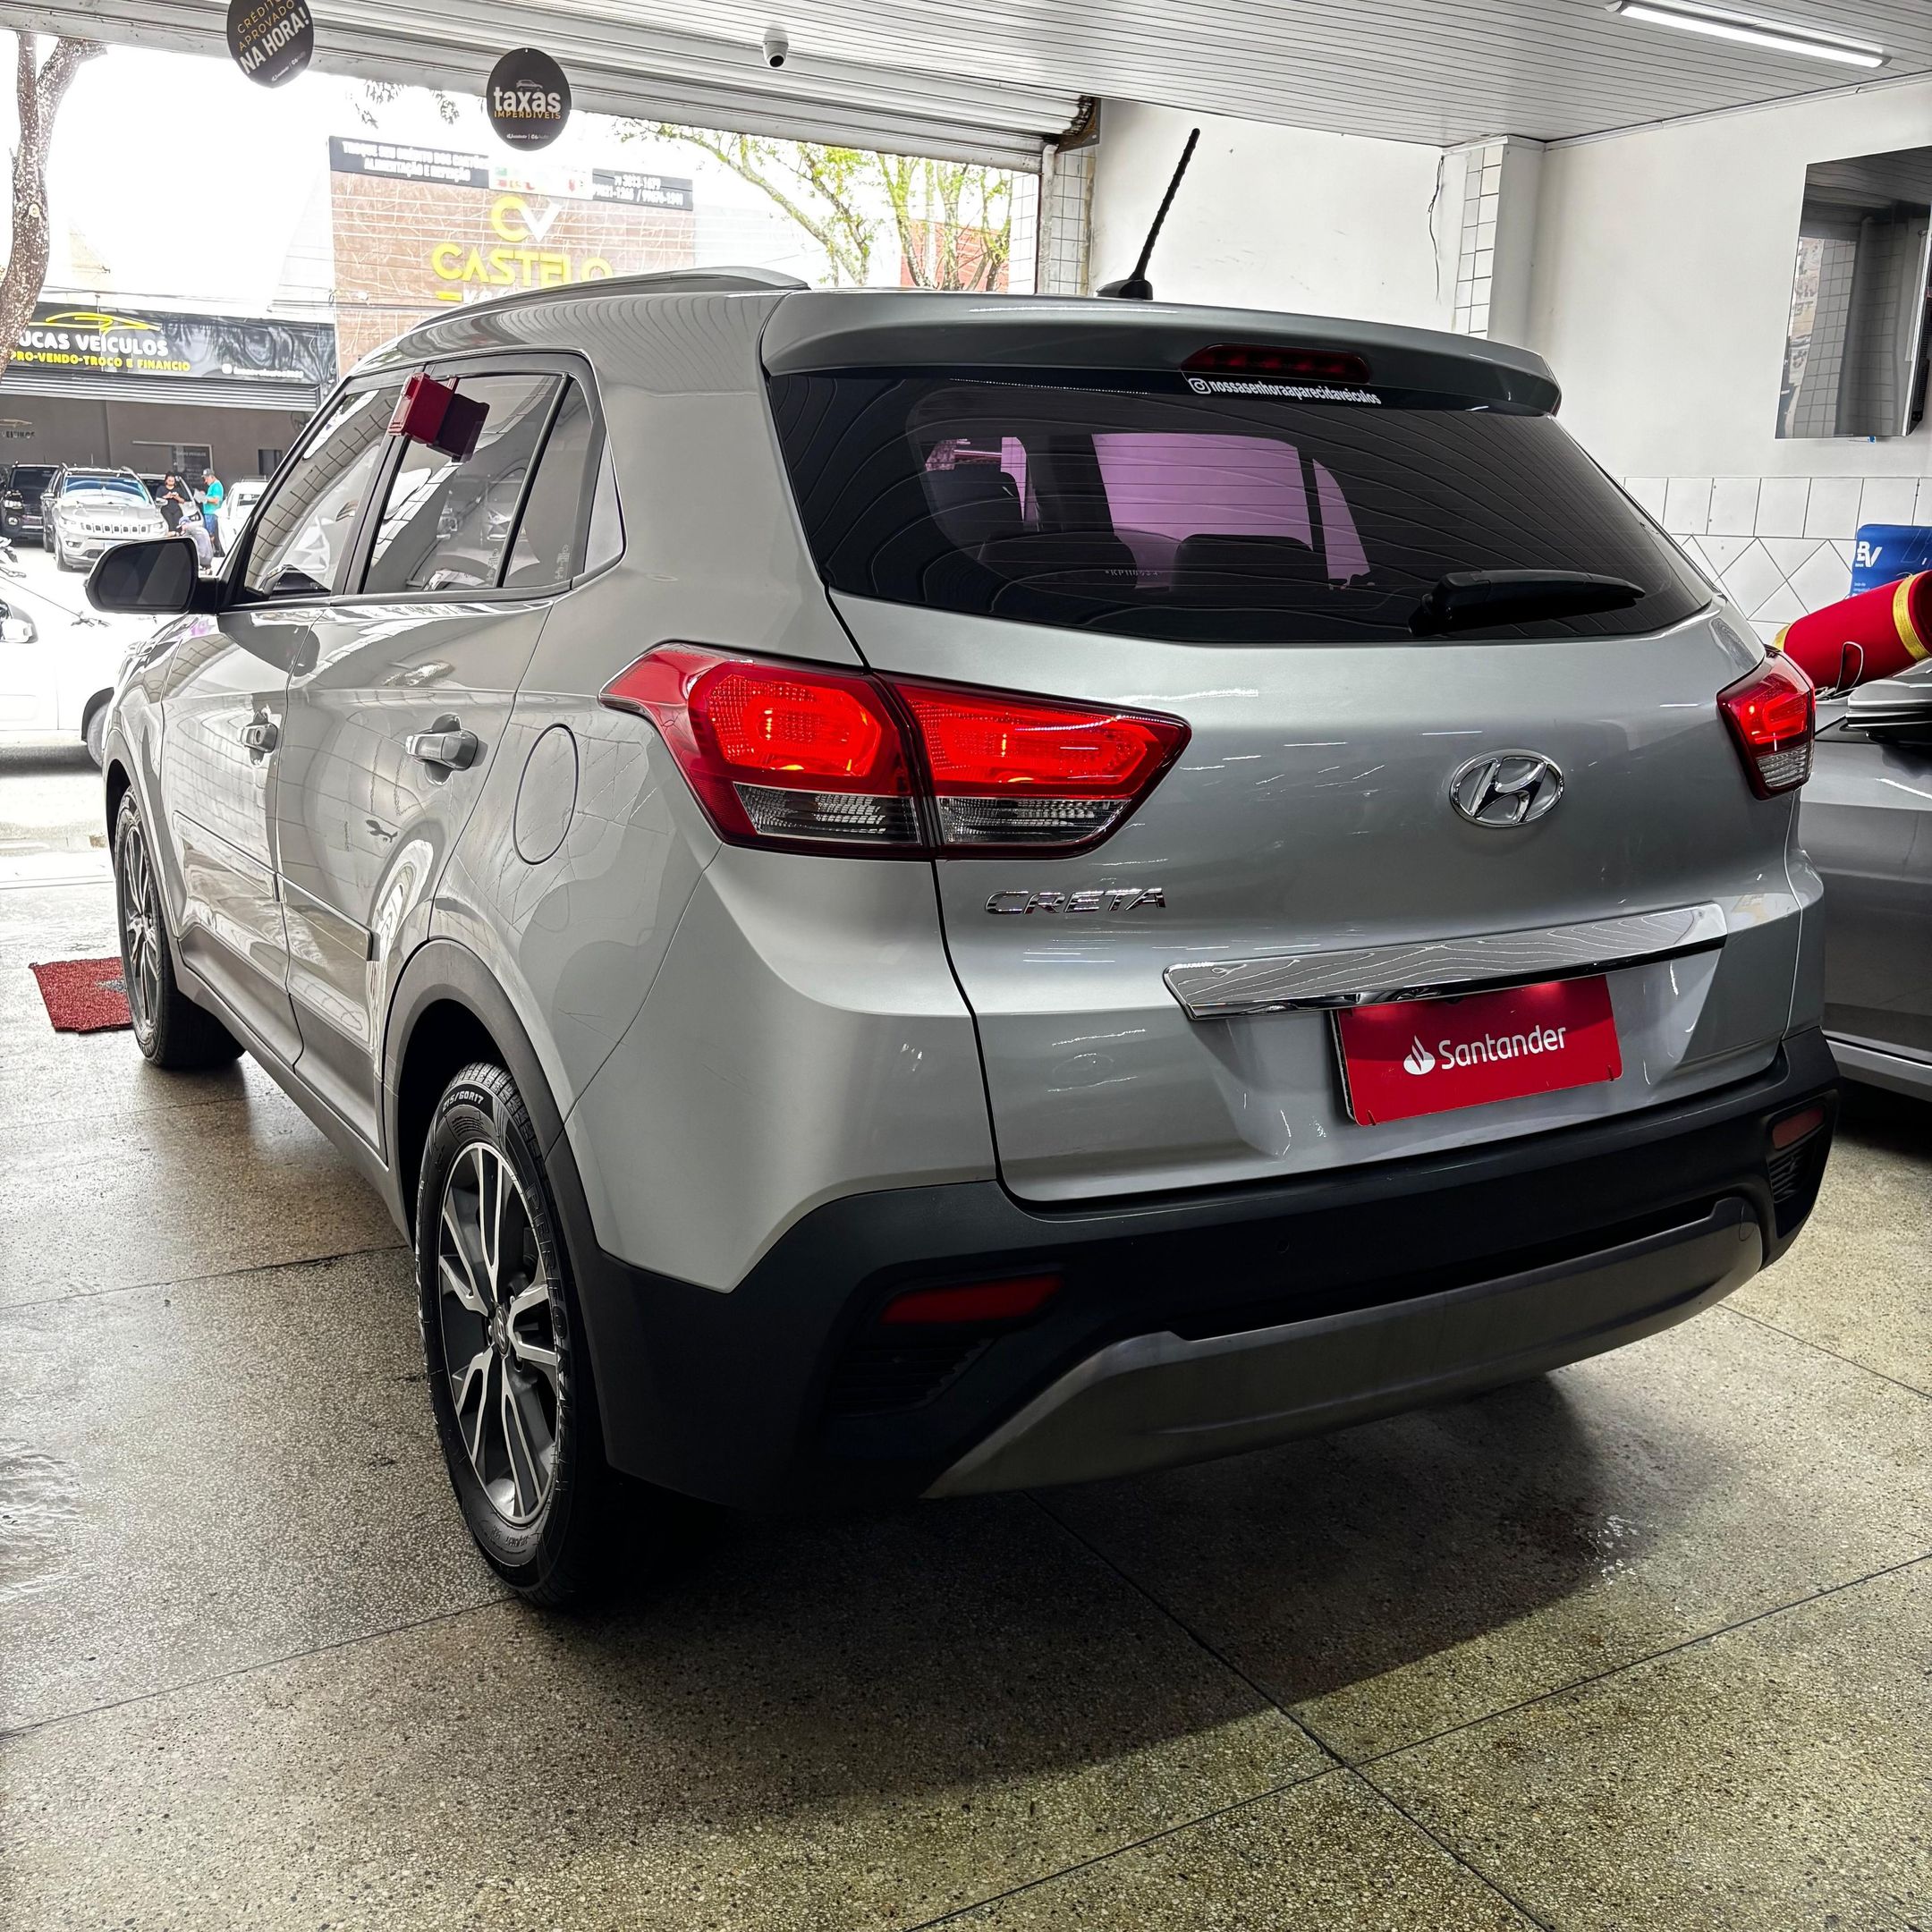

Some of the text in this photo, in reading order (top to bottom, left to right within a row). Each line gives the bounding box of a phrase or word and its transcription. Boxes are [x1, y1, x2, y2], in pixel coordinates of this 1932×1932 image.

[237, 0, 280, 34] CRÉDIT
[239, 0, 294, 51] APROVADO
[240, 46, 267, 74] NA
[262, 6, 309, 56] HORA!
[494, 87, 561, 113] taxas
[491, 196, 563, 243] CV
[19, 331, 71, 350] UCAS
[126, 358, 133, 369] E
[137, 360, 191, 371] FINANCIO
[1208, 380, 1382, 404] nossasenhoraaparecidaveiculos
[1857, 541, 1882, 567] BV
[985, 888, 1166, 914] CRETA
[1438, 1025, 1566, 1070] Santander
